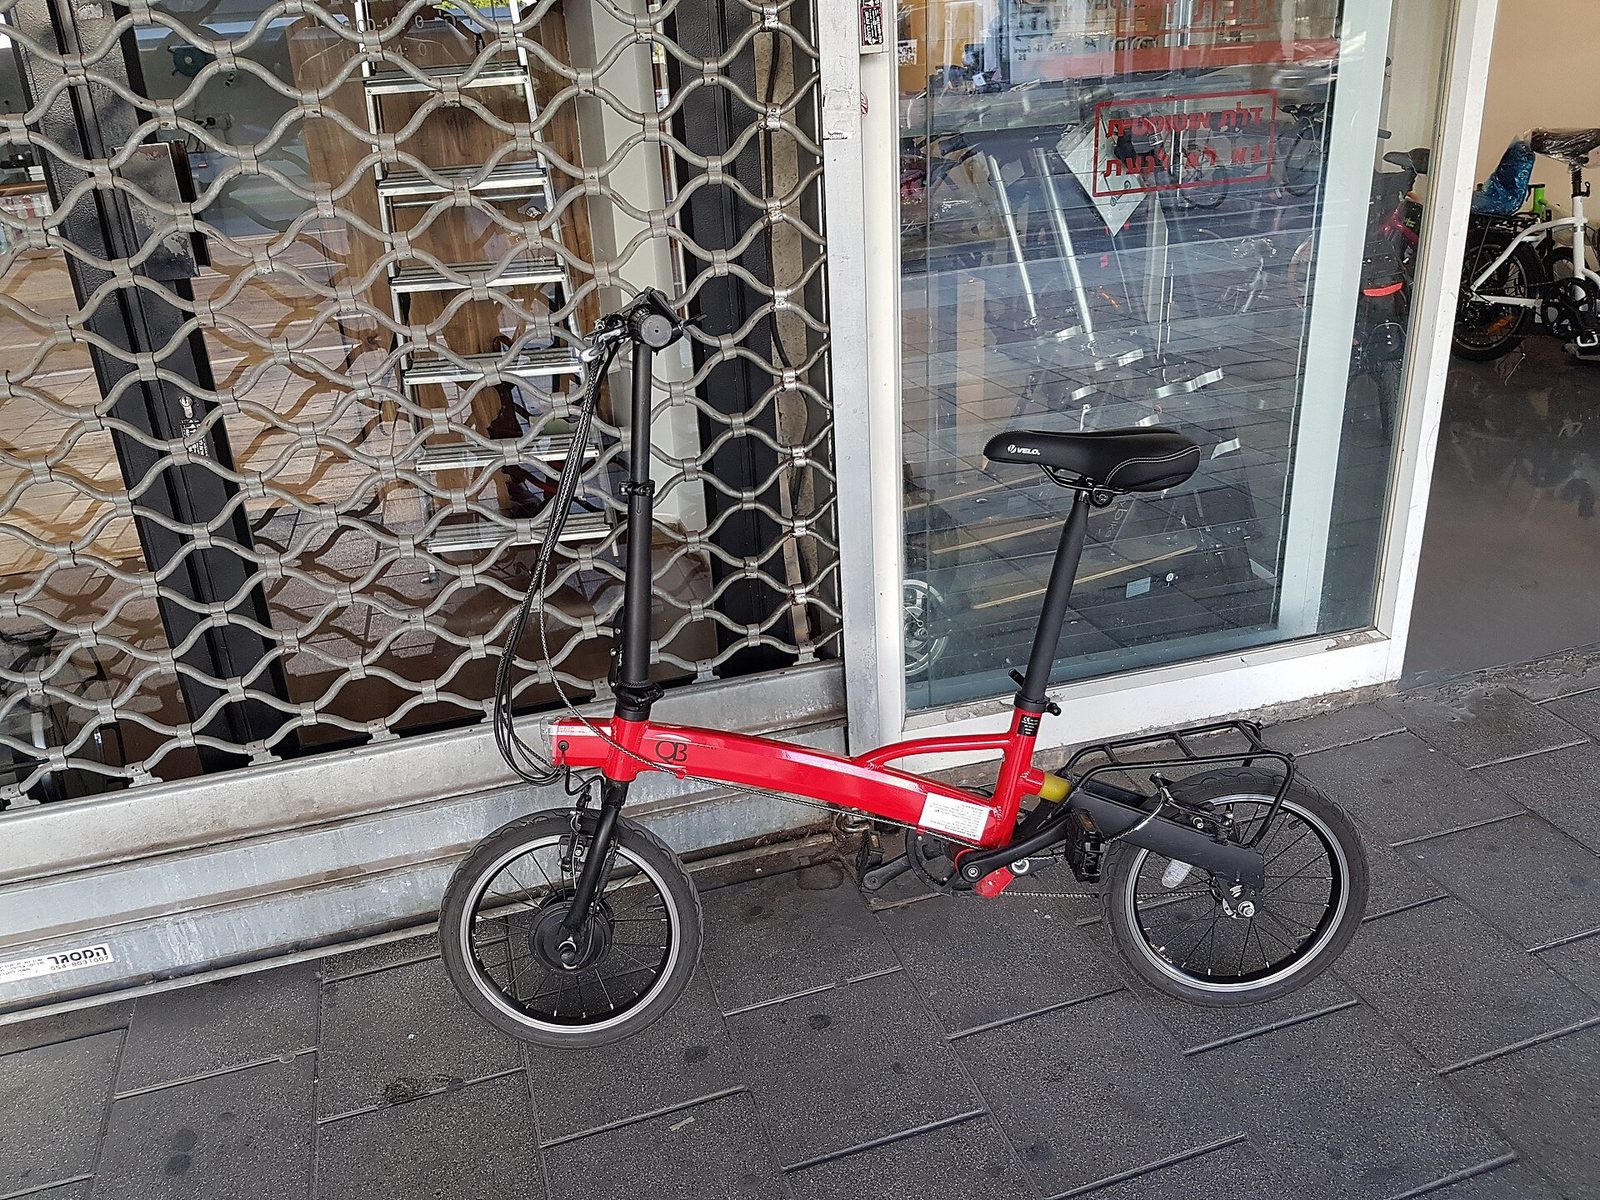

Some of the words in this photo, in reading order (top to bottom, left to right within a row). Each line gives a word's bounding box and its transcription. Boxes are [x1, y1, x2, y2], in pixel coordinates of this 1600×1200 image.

[1106, 111, 1211, 138] אוטומטית
[1218, 101, 1263, 128] דלת
[1104, 147, 1169, 177] לגעת
[1184, 144, 1217, 169] לא
[1231, 144, 1261, 164] נא
[47, 946, 108, 965] המסגר
